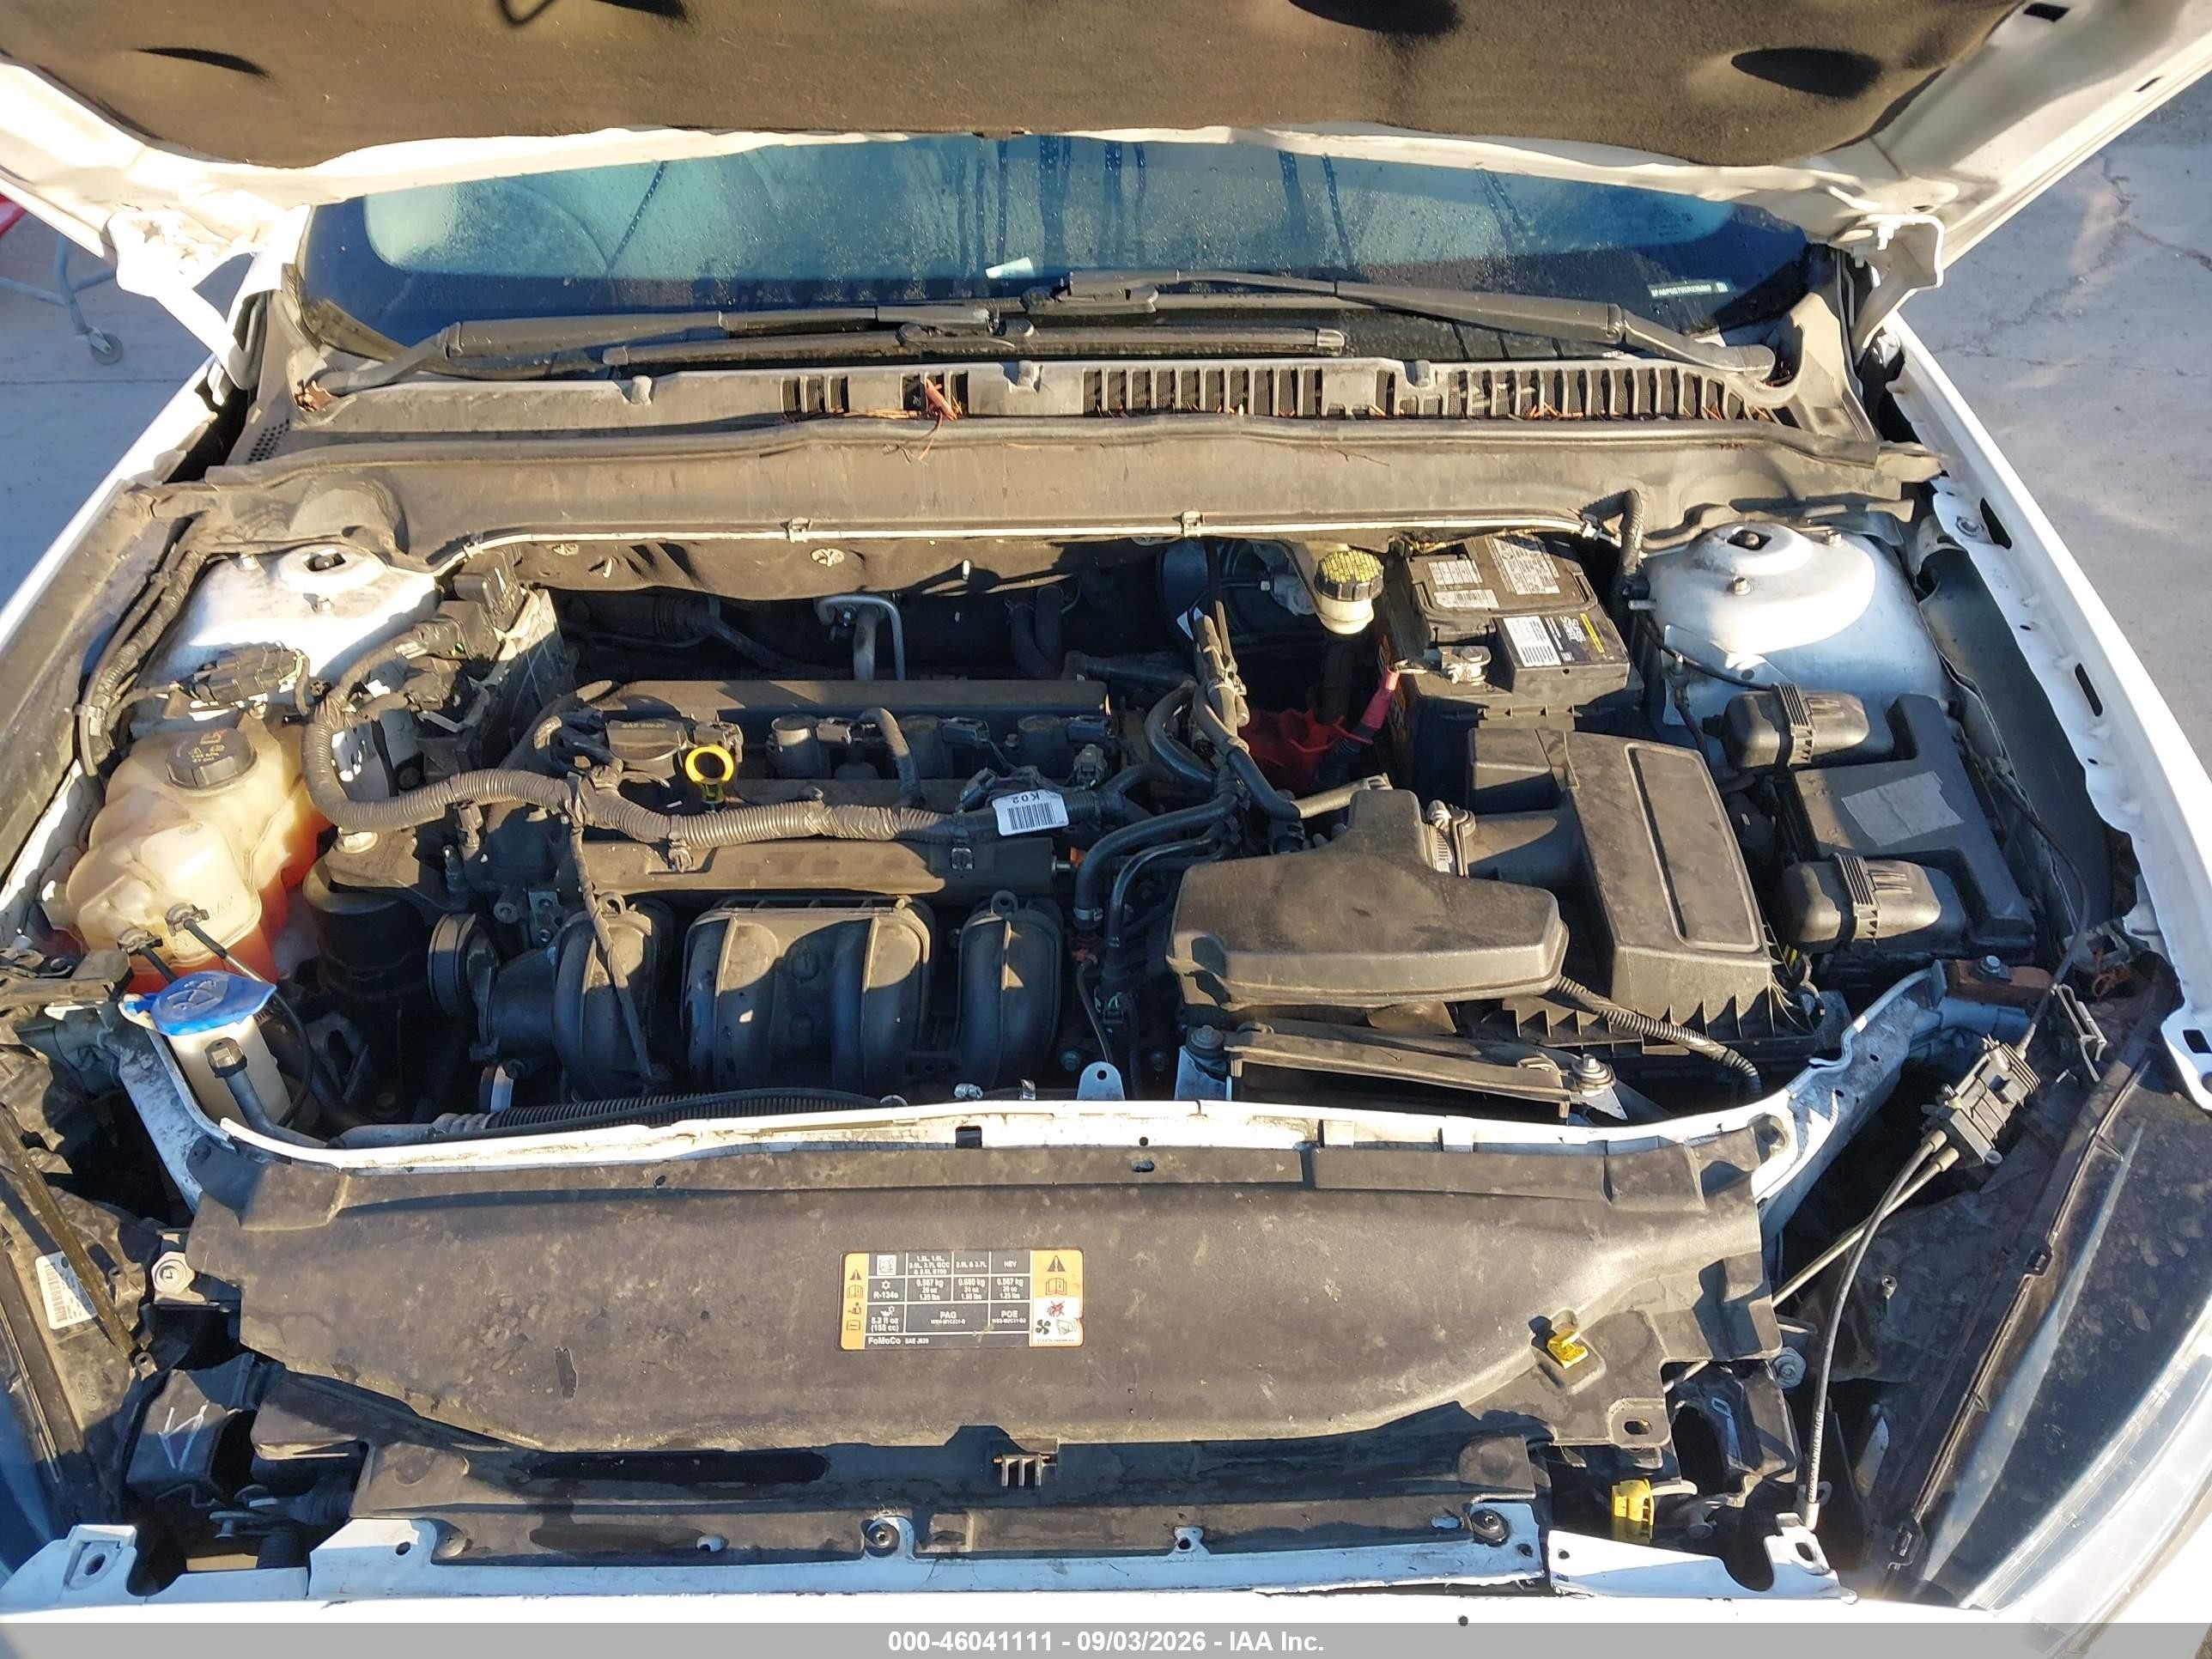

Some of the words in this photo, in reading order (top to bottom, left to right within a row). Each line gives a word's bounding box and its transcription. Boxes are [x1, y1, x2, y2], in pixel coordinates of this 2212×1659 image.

[1012, 793, 1040, 804] K02
[934, 1279, 945, 1288] kg
[976, 1278, 986, 1288] kg
[1014, 1277, 1024, 1287] kg
[872, 1291, 899, 1299] R-134a
[939, 1310, 957, 1320] PAG
[1000, 1310, 1019, 1319] POE
[867, 1336, 902, 1346] FoMoCo
